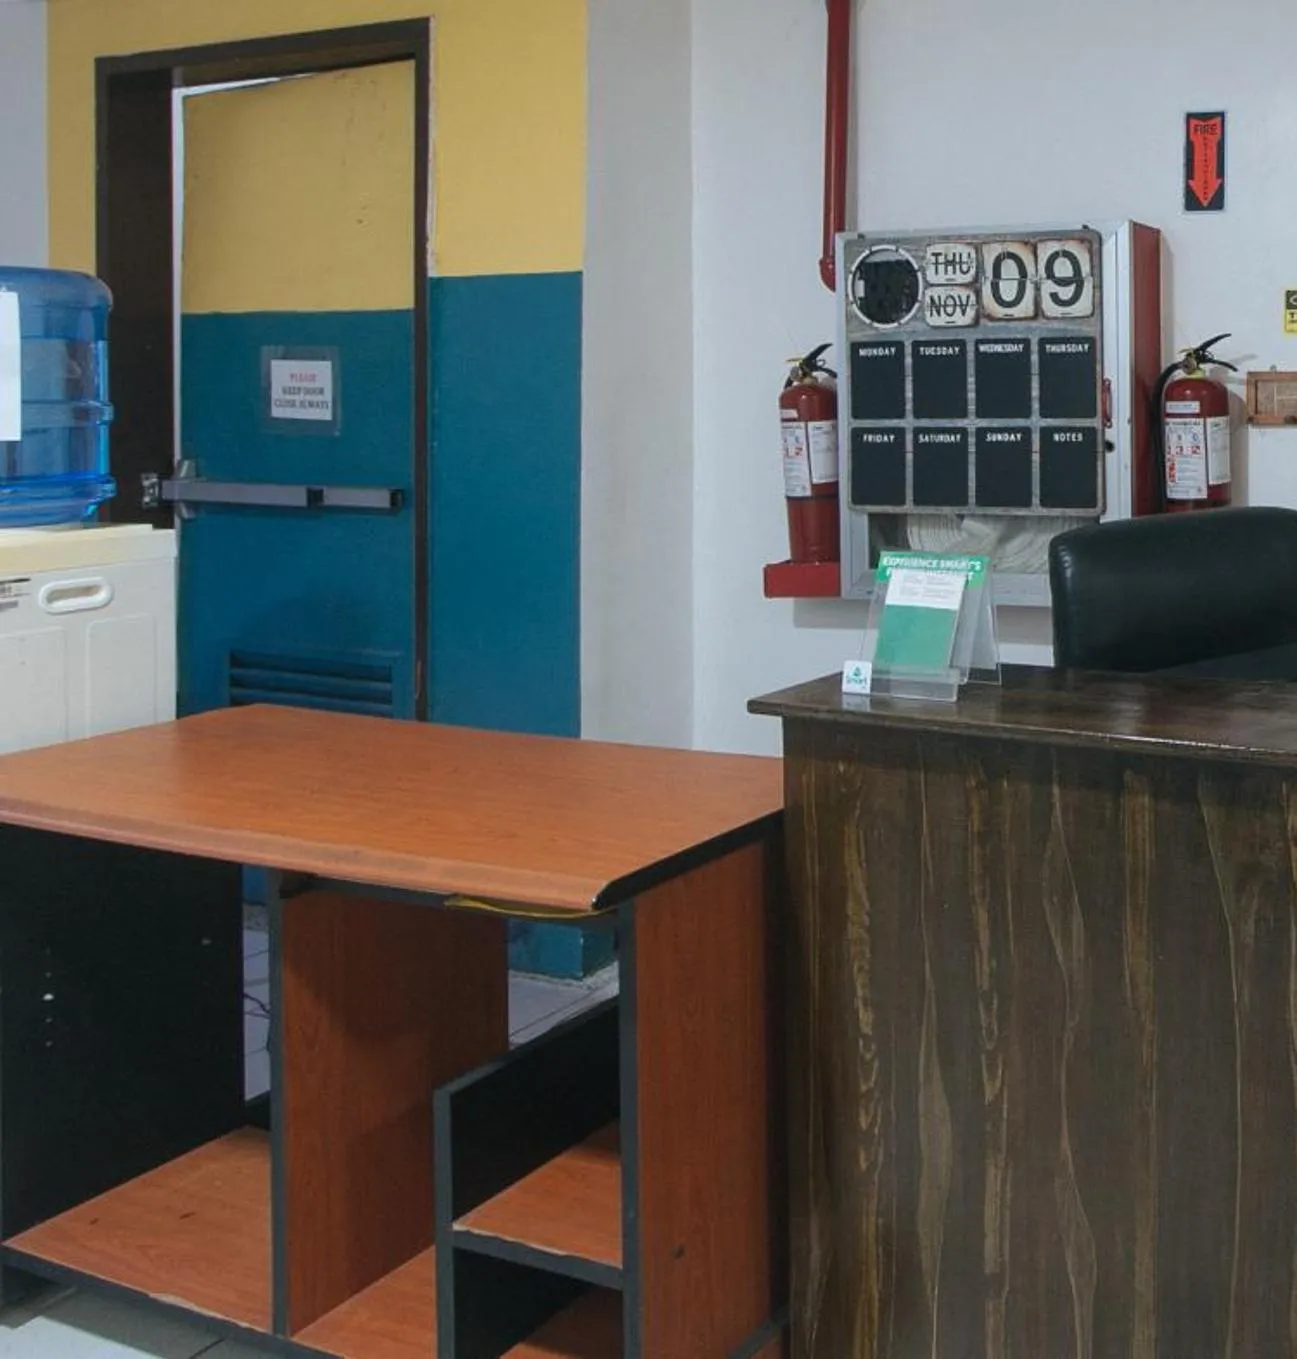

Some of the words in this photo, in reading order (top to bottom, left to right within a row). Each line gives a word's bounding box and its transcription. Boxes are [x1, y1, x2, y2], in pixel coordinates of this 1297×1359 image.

[1194, 123, 1218, 135] FIRE
[930, 251, 972, 276] THU
[929, 294, 970, 318] NOV
[859, 346, 896, 357] MONDAY
[919, 345, 960, 356] TUESDAY
[978, 343, 1025, 353] WEDNESDAY
[1045, 343, 1090, 353] THURSDAY
[863, 434, 896, 443] FRIDAY
[918, 433, 961, 443] SATURDAY
[985, 432, 1022, 442] SUNDAY
[1053, 432, 1083, 442] NOTES
